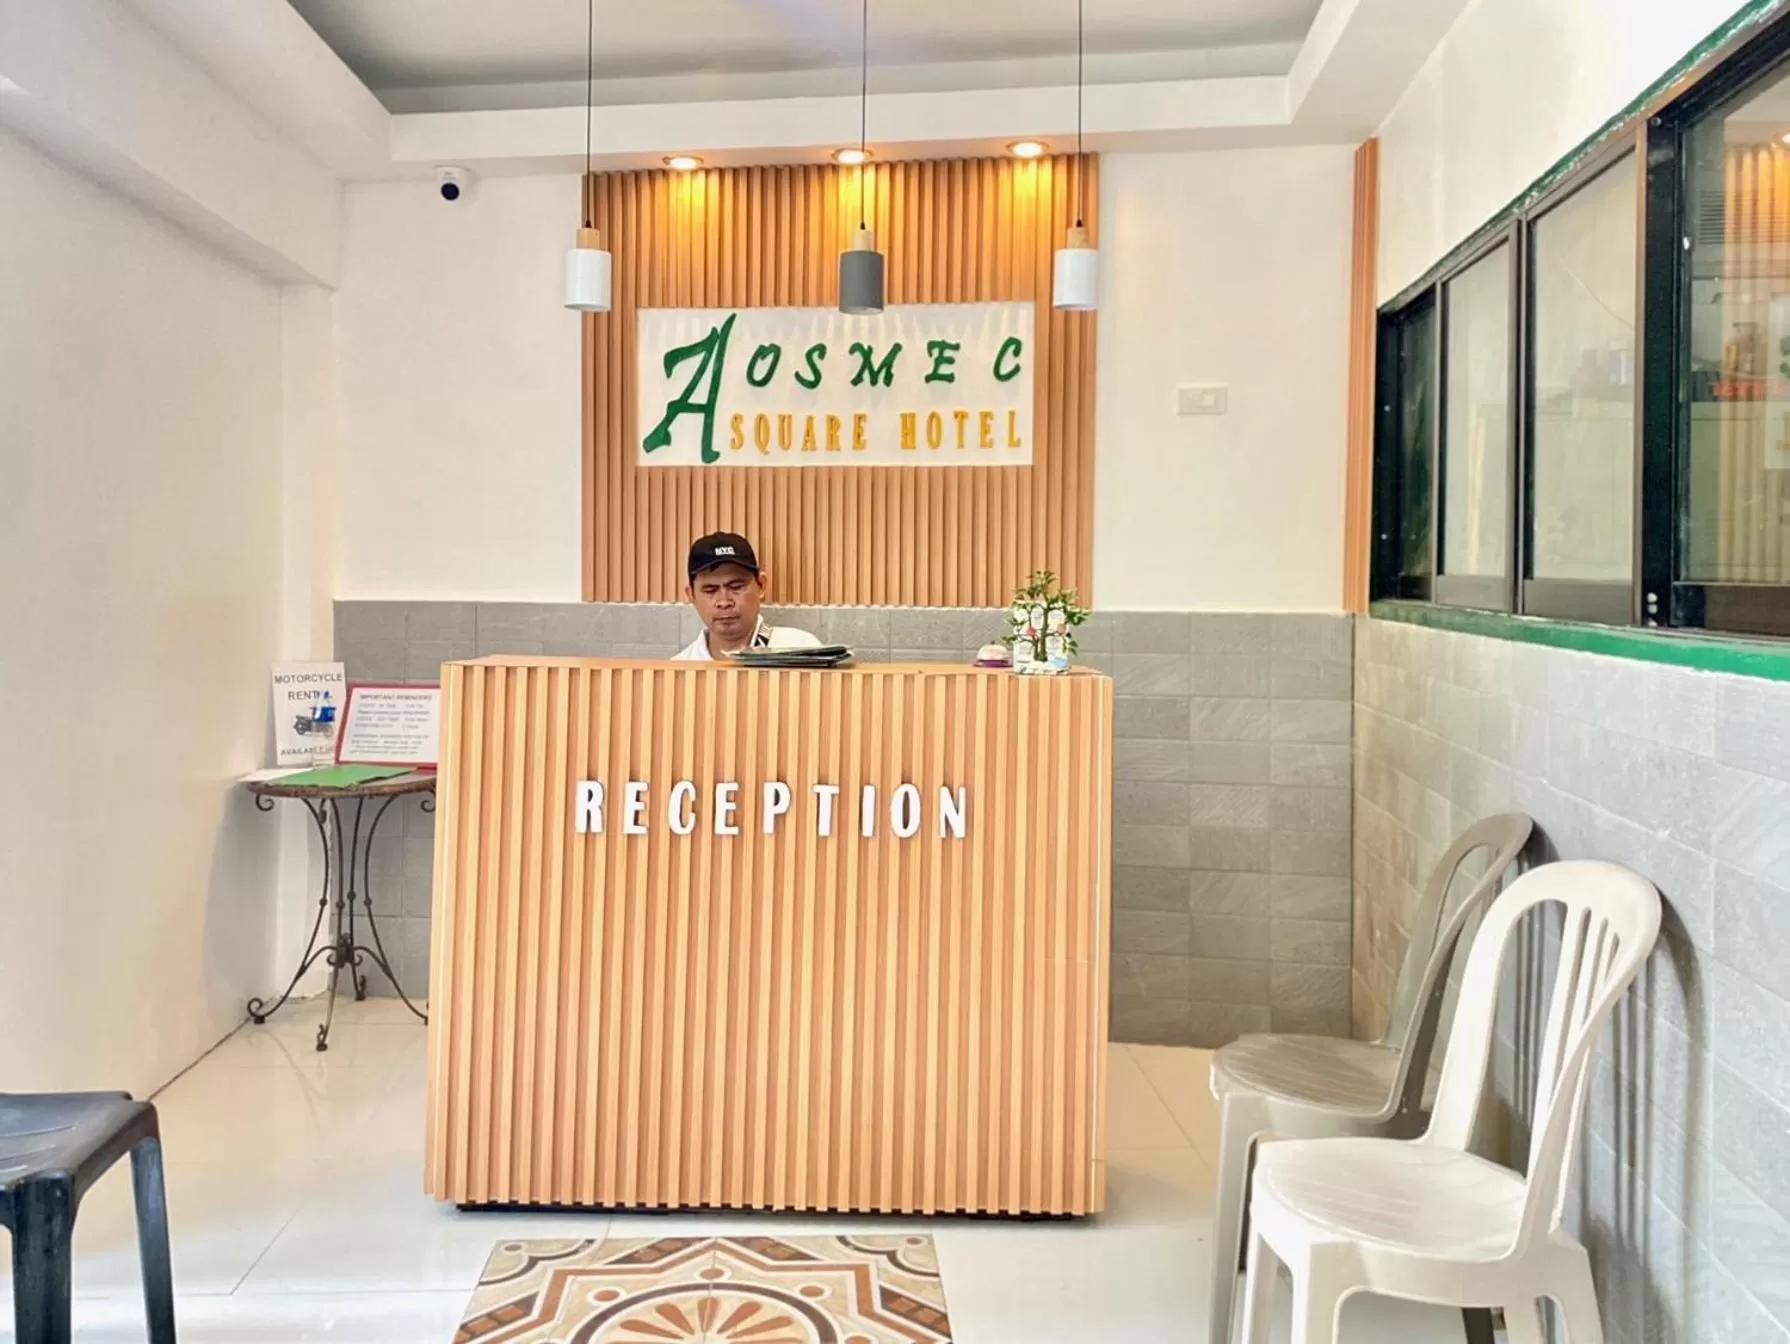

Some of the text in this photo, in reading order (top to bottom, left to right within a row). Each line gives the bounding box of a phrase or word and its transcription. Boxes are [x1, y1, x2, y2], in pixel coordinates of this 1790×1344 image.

[729, 410, 1022, 456] SQUARE HOTEL
[274, 673, 343, 684] MOTORCYCLE
[288, 690, 333, 701] RENT
[575, 780, 967, 838] RECEPTION
